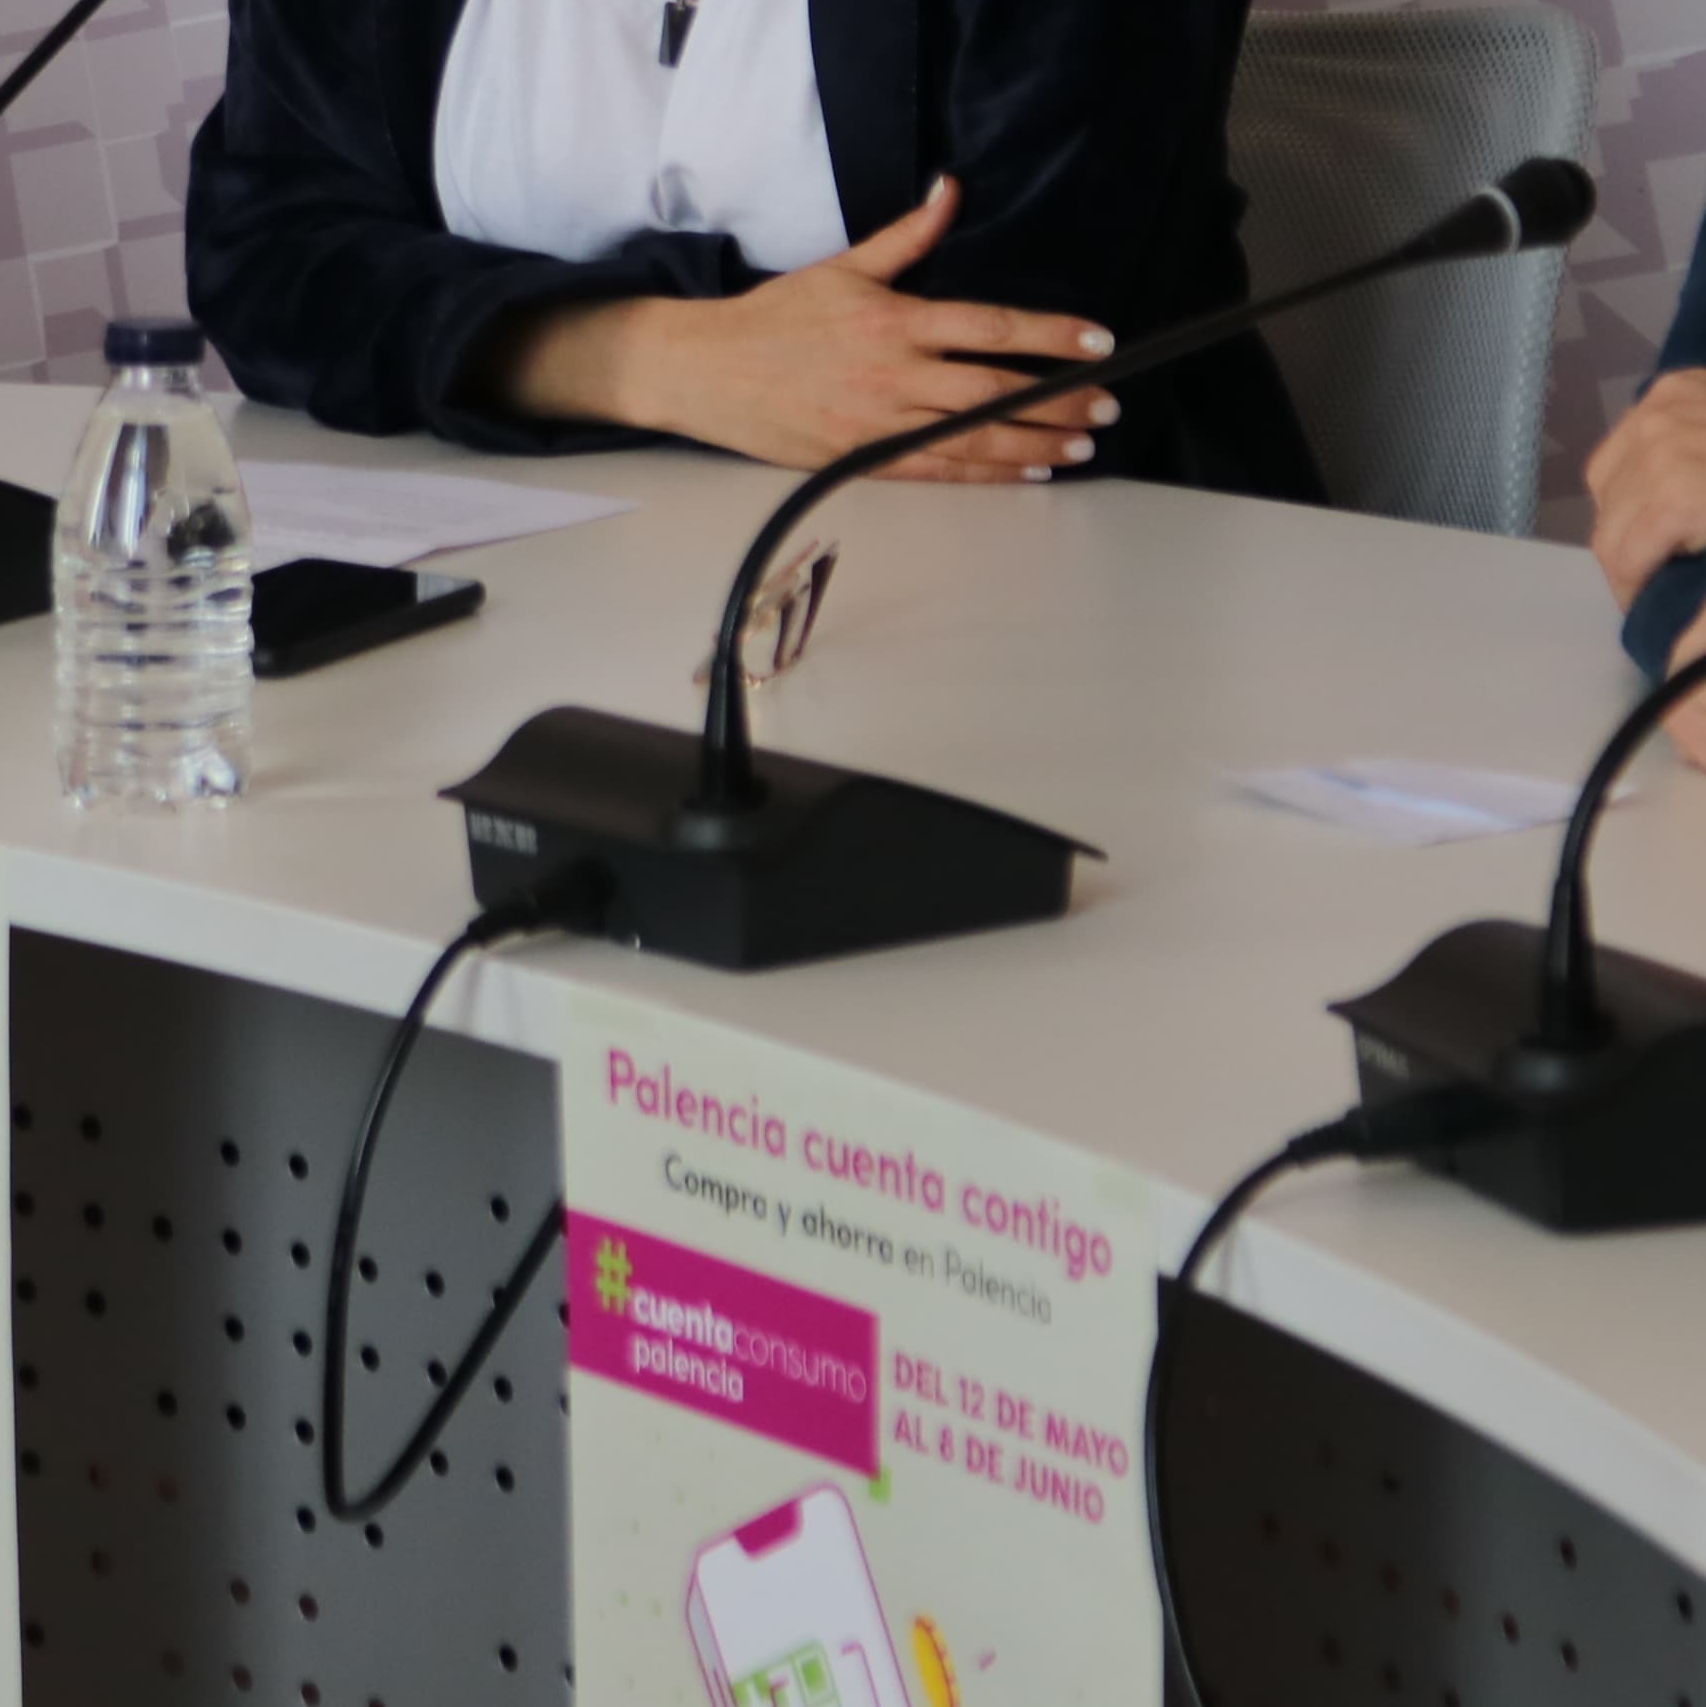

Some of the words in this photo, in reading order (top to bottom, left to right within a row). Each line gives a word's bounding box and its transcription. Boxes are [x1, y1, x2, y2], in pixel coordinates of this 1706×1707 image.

[608, 1049, 786, 1157] Palencia
[803, 1126, 945, 1213] cuenta
[962, 1181, 1113, 1280] contigo
[664, 1154, 768, 1220] Compra
[777, 1202, 793, 1235] y
[801, 1204, 894, 1264] ahorra
[904, 1244, 935, 1277] en
[945, 1251, 1052, 1324] Palencia
[633, 1334, 743, 1403] palencia
[894, 1351, 948, 1407] DEL
[959, 1376, 985, 1418] 12
[996, 1391, 1034, 1440] DE
[1045, 1409, 1129, 1478] MAYO
[894, 1407, 929, 1456] AL
[939, 1428, 954, 1462] 8
[966, 1435, 1003, 1484] DE
[1013, 1453, 1105, 1525] JUNIO
